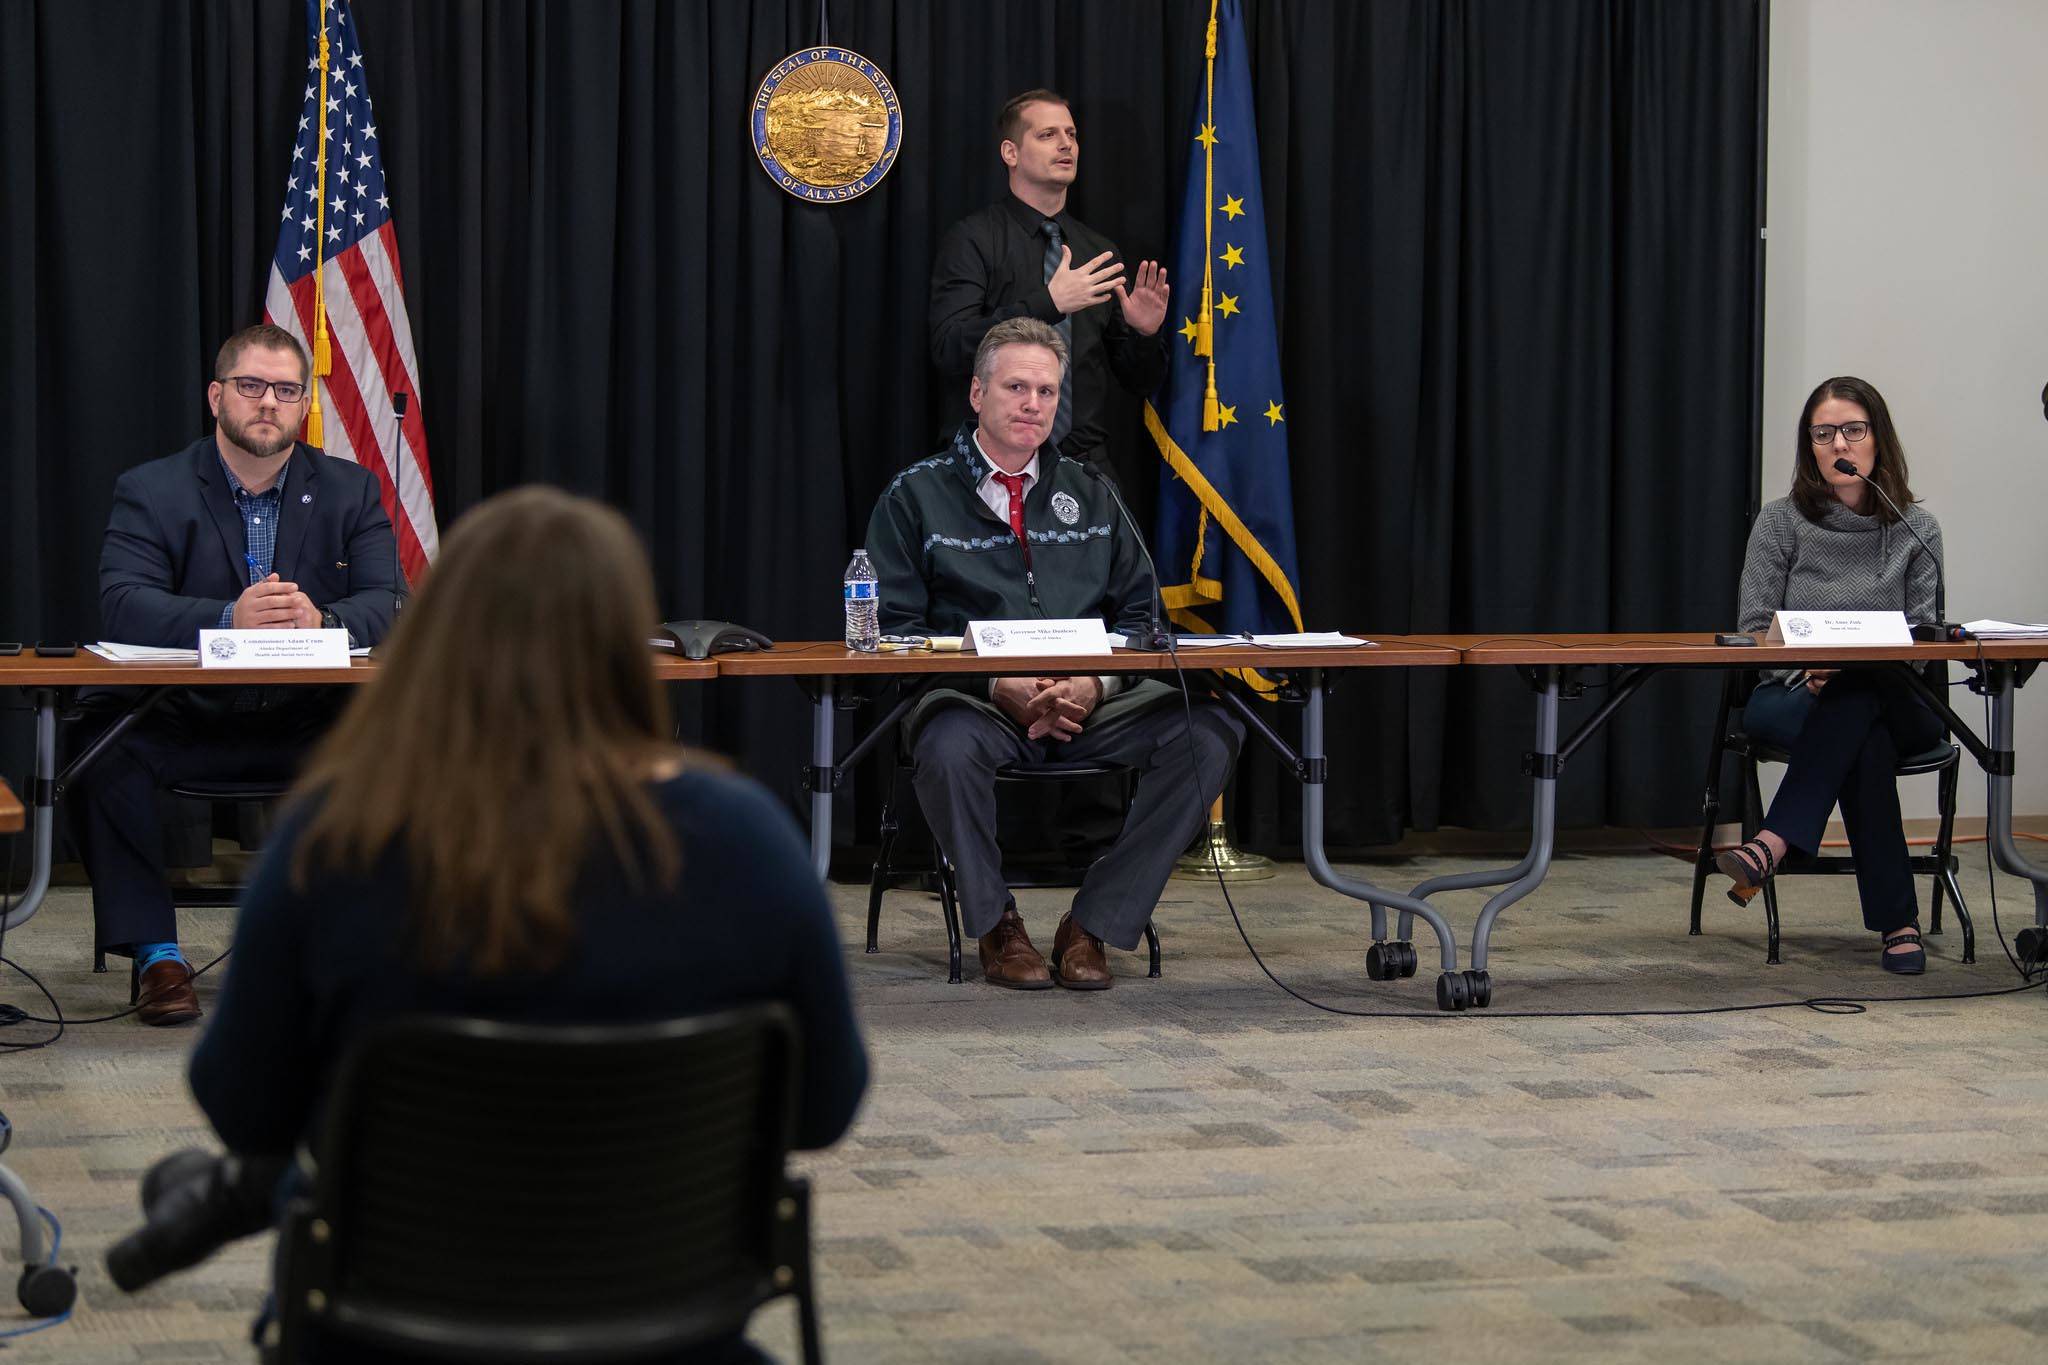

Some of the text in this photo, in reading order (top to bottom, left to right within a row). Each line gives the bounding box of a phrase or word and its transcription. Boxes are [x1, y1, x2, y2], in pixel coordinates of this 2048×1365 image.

[756, 50, 899, 114] THE SEAL OF THE STATE
[782, 176, 869, 200] OF ALASKA
